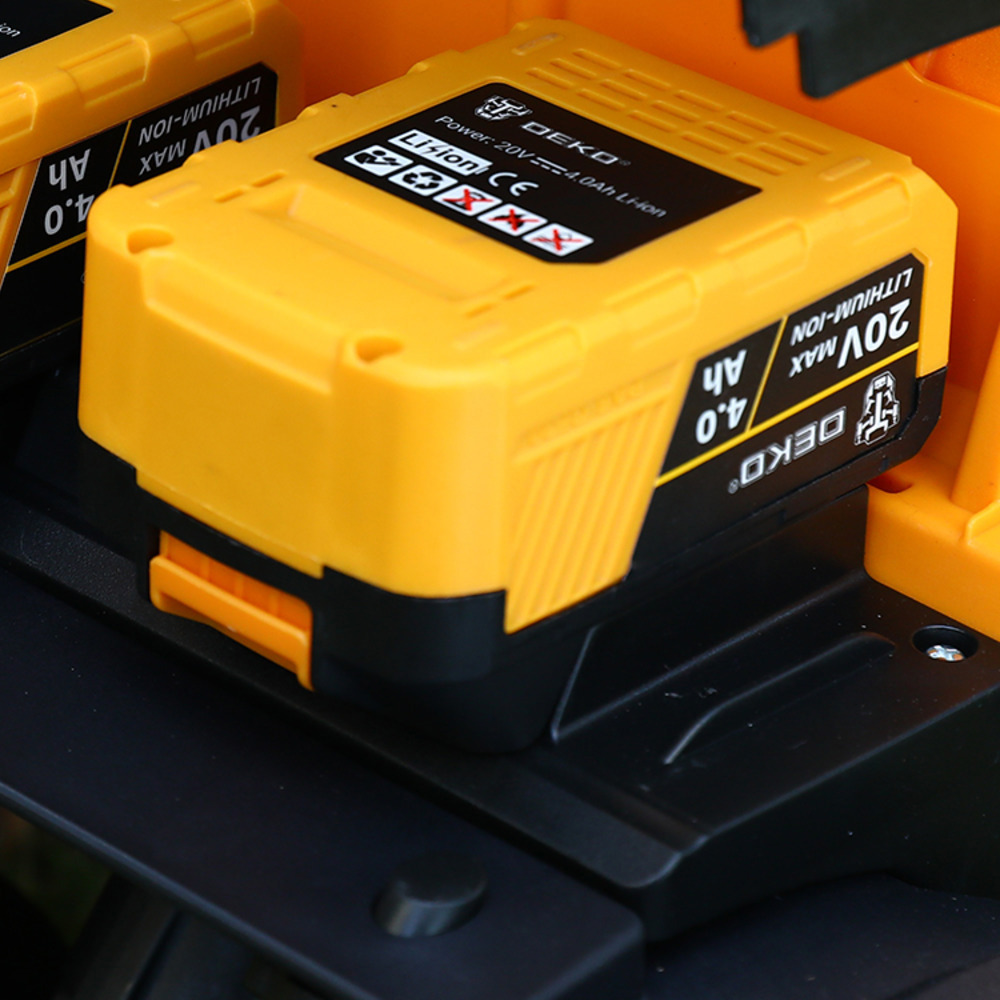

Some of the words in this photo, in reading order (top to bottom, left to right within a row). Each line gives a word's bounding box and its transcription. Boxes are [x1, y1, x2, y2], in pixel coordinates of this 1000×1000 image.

[137, 75, 261, 147] LITHIUM-ION
[138, 138, 187, 176] MAX
[520, 120, 619, 165] DEKO
[49, 148, 91, 191] Ah
[434, 115, 496, 145] Power:
[615, 192, 667, 219] Li-ion
[44, 193, 95, 236] 4.0
[789, 266, 914, 347] LITHIUM-ION
[788, 335, 839, 379] MAX
[836, 298, 911, 370] 20V
[702, 348, 747, 397] Ah
[695, 397, 748, 445] 4.0
[739, 405, 847, 488] DEKO
